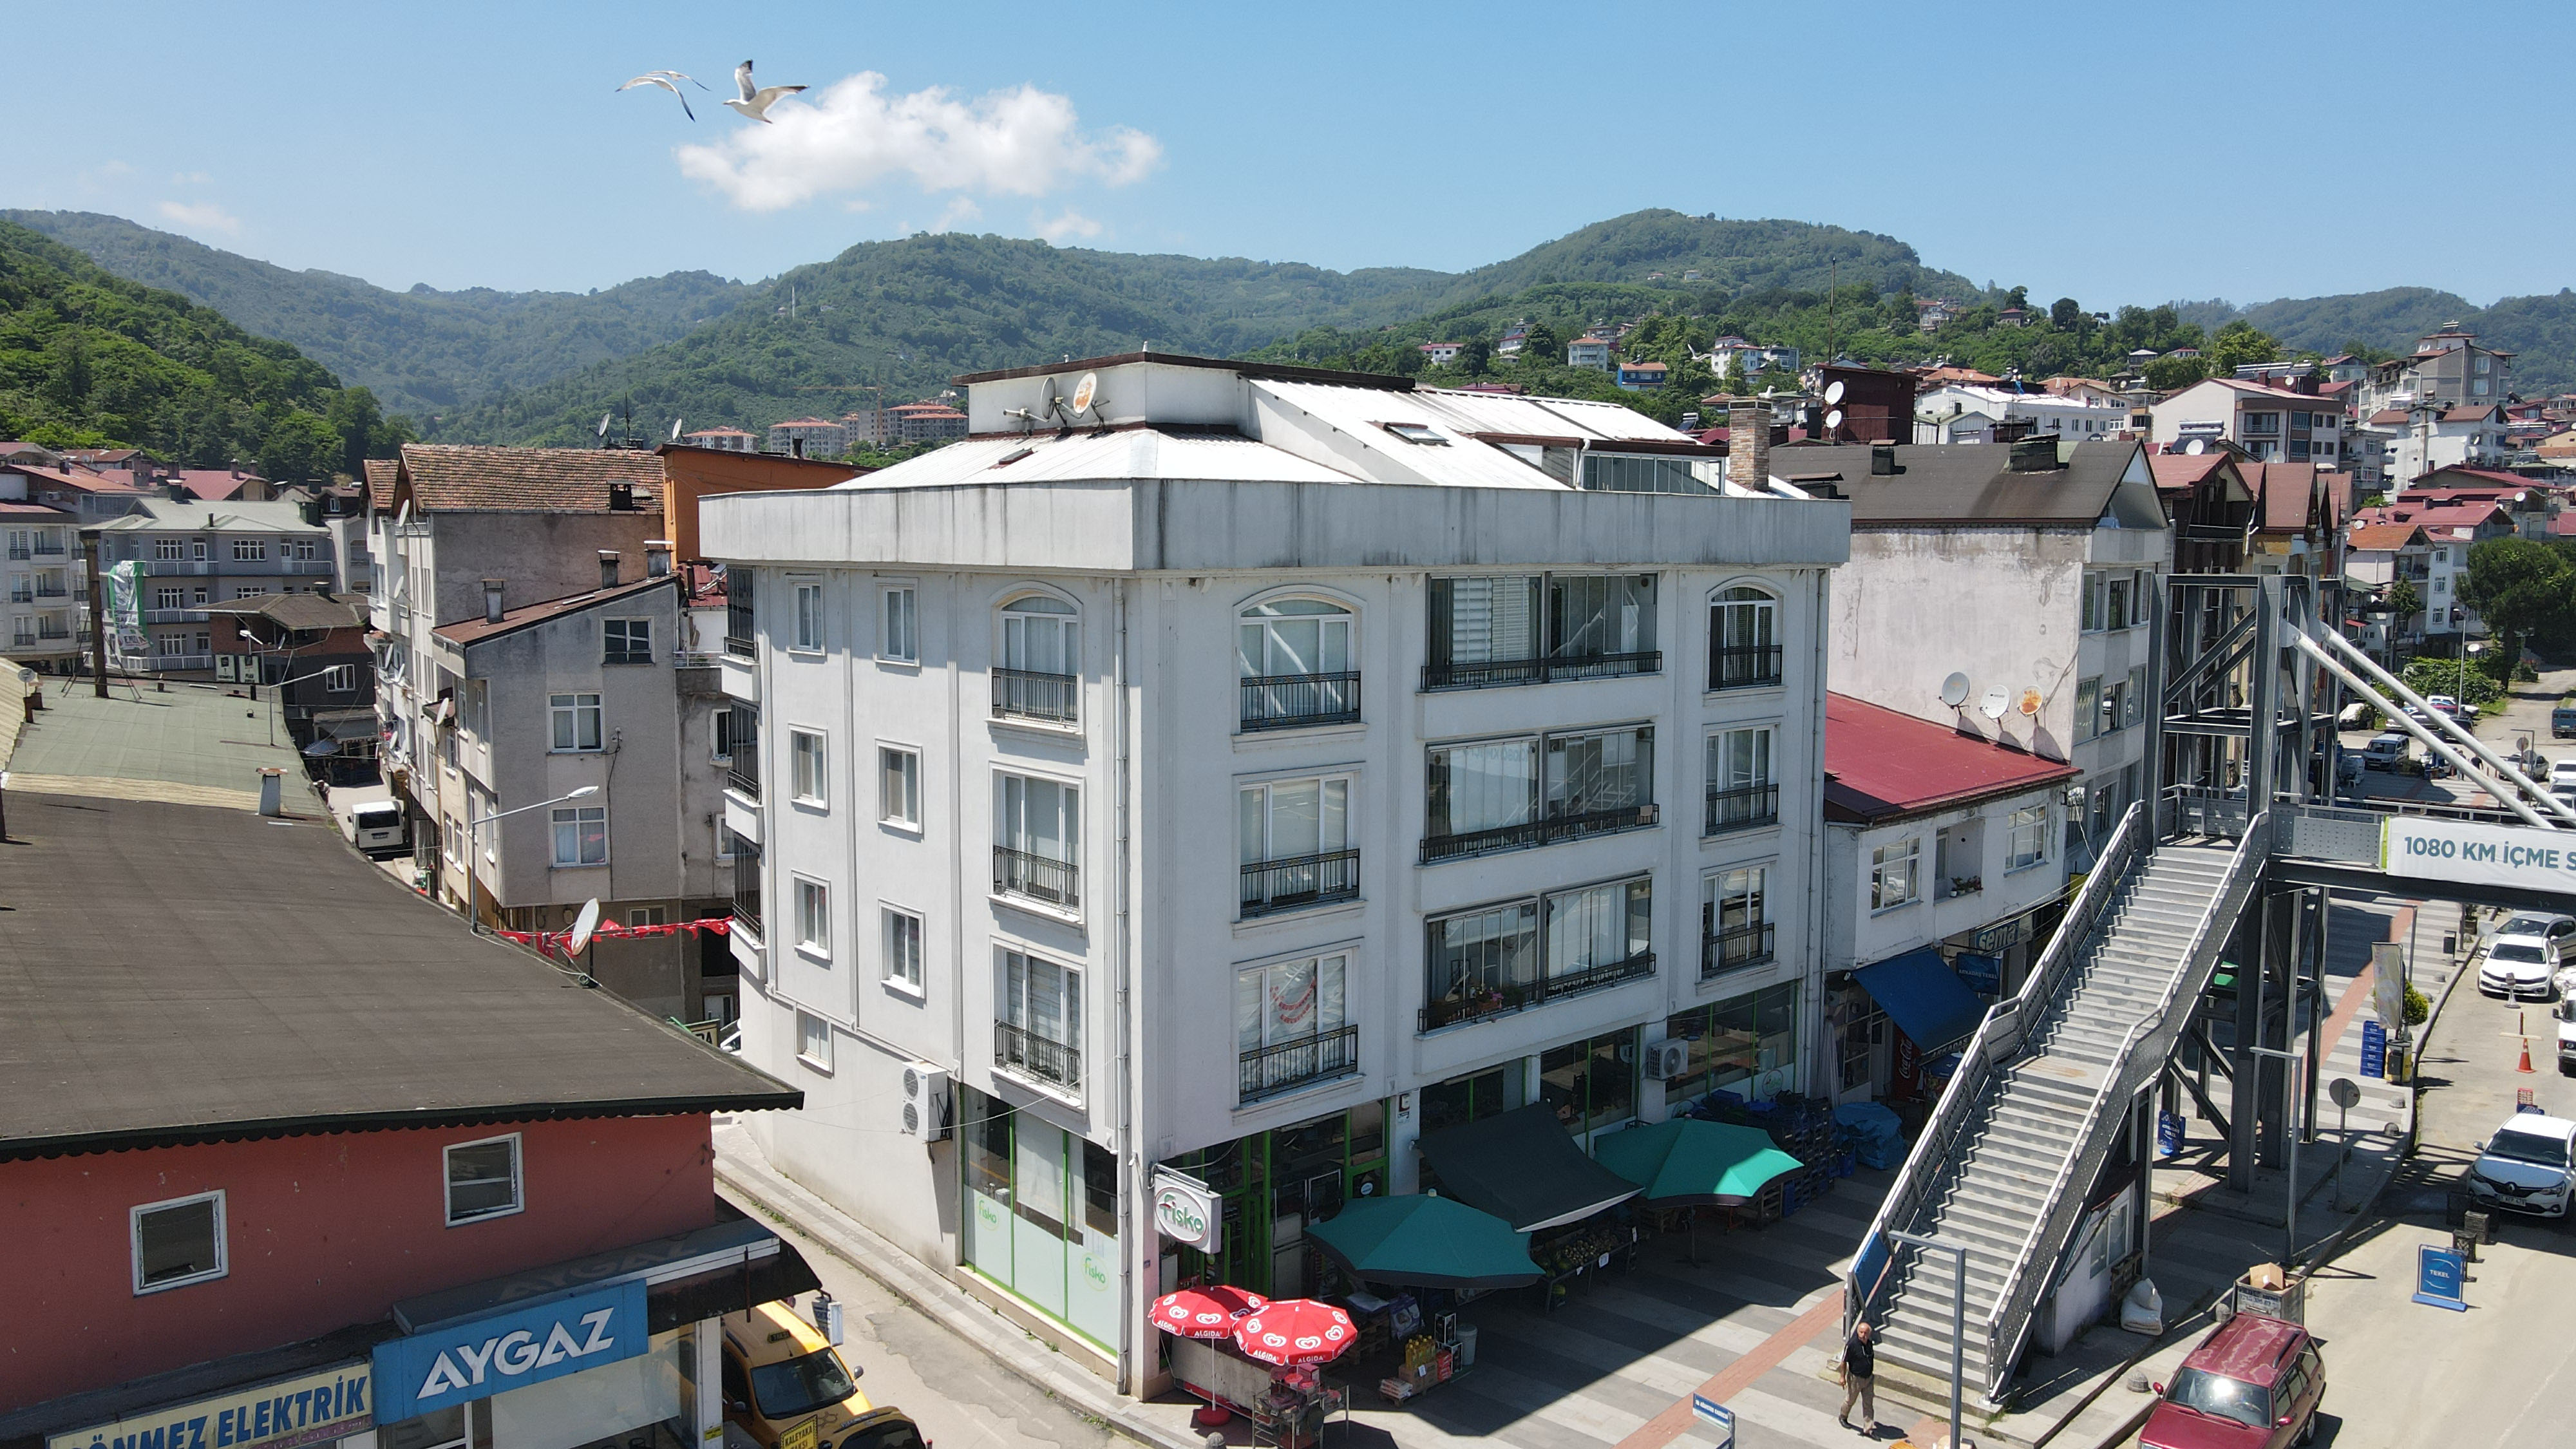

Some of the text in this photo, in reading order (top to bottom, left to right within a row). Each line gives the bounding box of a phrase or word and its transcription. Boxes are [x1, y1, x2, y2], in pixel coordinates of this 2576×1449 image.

[2405, 837, 2456, 858] 1080
[2463, 841, 2496, 863] KM
[2503, 841, 2560, 869] İÇME
[1157, 1320, 1177, 1332] ALGIDA
[416, 1307, 614, 1399] AYGAZ
[1253, 1349, 1277, 1363] ALGIDA
[72, 1415, 209, 1449] MEZ
[217, 1375, 368, 1448] ELEKTRİK
[785, 1425, 813, 1447] KALEYAKA
